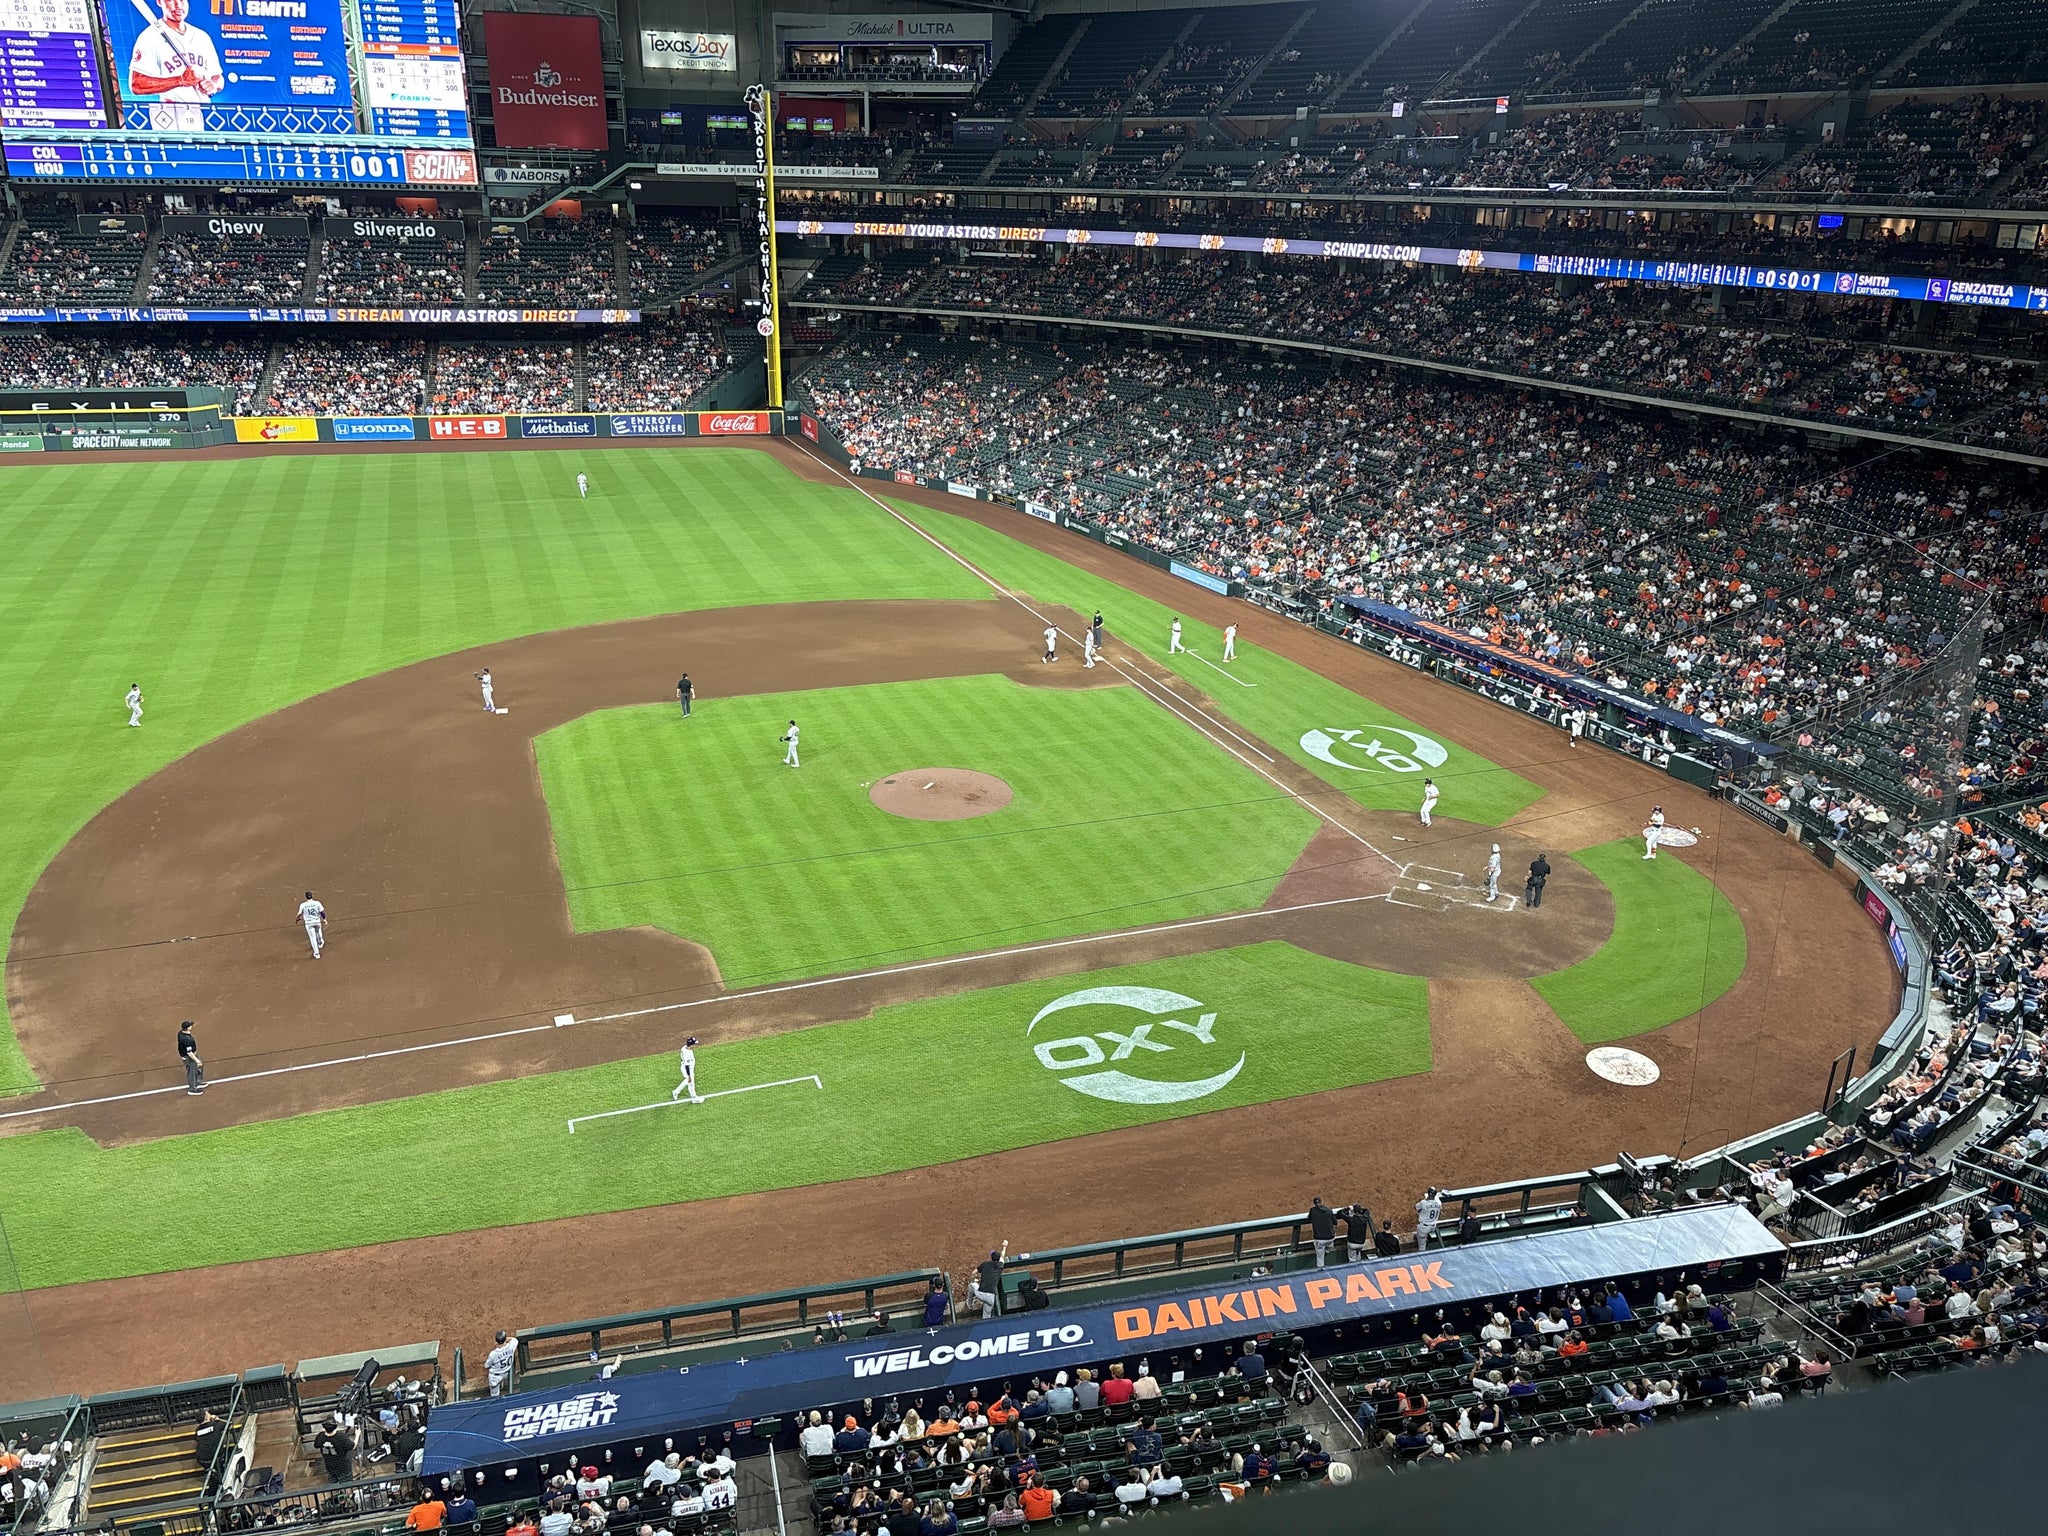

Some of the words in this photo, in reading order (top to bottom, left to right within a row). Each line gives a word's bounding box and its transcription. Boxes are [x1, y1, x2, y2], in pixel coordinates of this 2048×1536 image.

[246, 1, 306, 17] SMITH
[221, 24, 264, 32] HOMETOWN
[290, 26, 327, 34] BIRTHDAY
[847, 22, 893, 36] Michelob
[908, 23, 955, 35] ULTRA
[678, 59, 701, 67] CREDIT
[704, 60, 727, 68] UNION
[754, 121, 766, 172] ROOT
[32, 147, 60, 159] COL
[87, 149, 95, 160] 1
[105, 150, 114, 160] 2
[124, 149, 132, 160] 0
[142, 150, 148, 160] 1
[160, 150, 167, 161] 1
[253, 152, 261, 162] 5
[276, 153, 284, 163] 9
[294, 153, 302, 164] 2
[312, 153, 320, 164] 2
[330, 154, 338, 165] 2
[34, 163, 64, 174] HOU
[90, 164, 98, 174] 0
[108, 164, 115, 174] 1
[127, 164, 134, 175] 6
[144, 164, 152, 175] 0
[255, 166, 262, 176] 7
[278, 166, 285, 177] 7
[296, 167, 304, 177] 0
[314, 167, 321, 178] 2
[331, 167, 339, 178] 2
[511, 171, 559, 182] NABORS
[756, 178, 766, 191] 4
[757, 197, 769, 236] THA
[208, 219, 263, 234] Chevy
[353, 221, 436, 238] Silverado
[854, 223, 906, 235] STREAM
[909, 224, 943, 237] YOUR
[946, 226, 997, 239] ASTROS
[999, 228, 1045, 240] DIRECT
[1323, 241, 1420, 261] SCHNPLUS.COM
[1656, 266, 1663, 277] R
[1678, 268, 1686, 279] H
[1702, 269, 1710, 280] E
[1726, 270, 1732, 281] L
[1757, 272, 1763, 284] B
[1765, 270, 1776, 287] 0
[1779, 273, 1786, 285] S
[1788, 272, 1798, 289] 0
[1812, 273, 1820, 290] 1
[1858, 276, 1890, 288] SMITH
[1856, 287, 1870, 295] EXIT
[1869, 288, 1899, 297] VELOCITY:
[1951, 282, 2014, 297] SENZATELA
[1950, 294, 1964, 303] RHP,
[1966, 296, 1977, 304] 0-0
[2039, 297, 2047, 308] 3
[128, 309, 141, 321] K
[156, 313, 188, 321] CUTTER
[337, 309, 403, 322] STREAM
[409, 310, 451, 322] YOUR
[456, 310, 518, 322] ASTROS
[522, 310, 578, 322] DIRECT
[159, 413, 180, 422] 370
[351, 424, 412, 433] HONDA
[435, 420, 501, 434] H-E-B
[528, 422, 590, 434] Methodist
[73, 437, 100, 448] SPACE
[101, 436, 120, 447] CITY
[120, 438, 139, 447] HOME
[140, 437, 171, 447] NETWORK
[1324, 727, 1423, 772] OXY
[1741, 797, 1779, 823] WOODFOREST
[1034, 1013, 1217, 1069] OXY
[854, 1331, 1030, 1378] WELCOME
[1037, 1324, 1084, 1347] TO
[1113, 1284, 1297, 1341] DAIKIN
[1305, 1261, 1454, 1309] PARK
[500, 1356, 512, 1368] 50
[504, 1398, 595, 1426] CHASE
[503, 1421, 541, 1438] THE
[540, 1408, 618, 1434] FIGHT
[712, 1493, 729, 1508] 44
